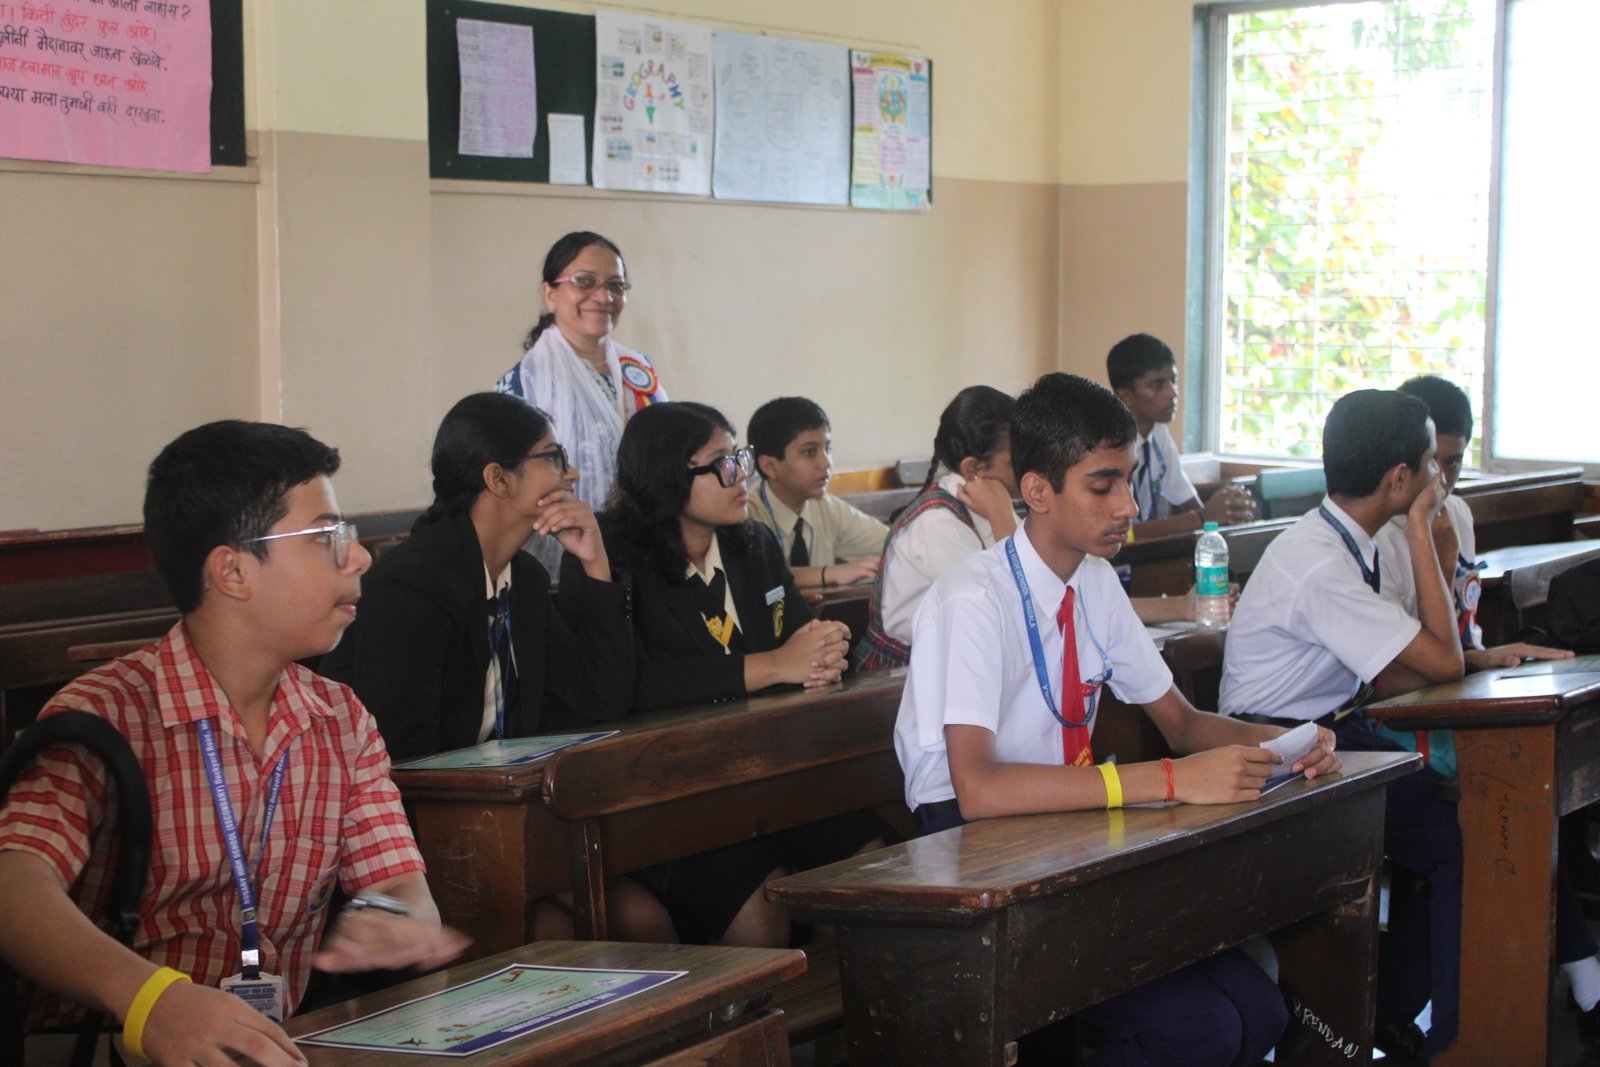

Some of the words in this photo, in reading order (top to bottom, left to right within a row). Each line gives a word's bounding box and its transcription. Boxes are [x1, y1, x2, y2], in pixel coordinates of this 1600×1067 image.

[623, 59, 686, 111] GEOGRAPHY
[208, 752, 223, 784] Dockyard
[216, 785, 235, 831] (SECONDARY)
[228, 831, 241, 859] SCHOOL
[235, 859, 245, 876] HIGH
[239, 878, 250, 905] ROSARY
